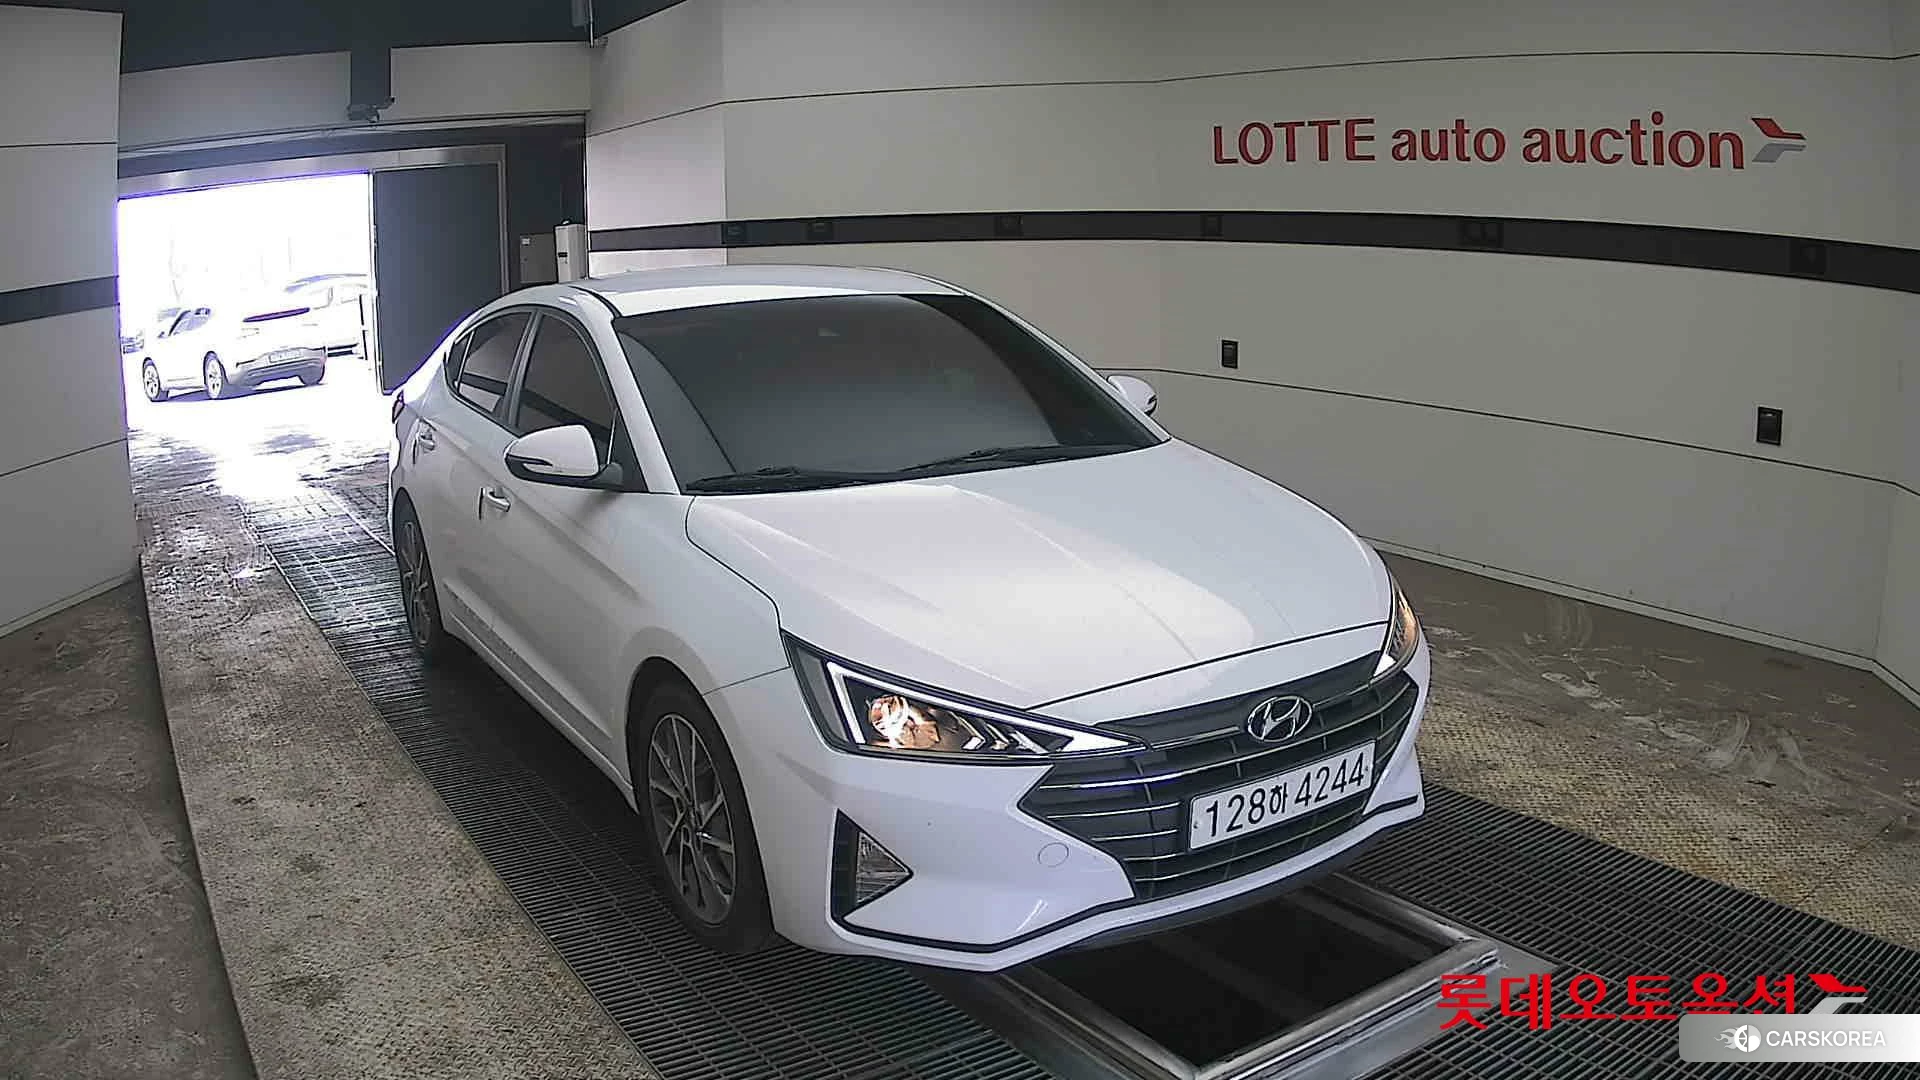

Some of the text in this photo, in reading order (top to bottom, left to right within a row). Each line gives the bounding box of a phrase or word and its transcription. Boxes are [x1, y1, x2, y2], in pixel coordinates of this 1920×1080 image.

[1212, 111, 1746, 169] LOTTE auto auction
[1206, 752, 1364, 837] 128하 4244
